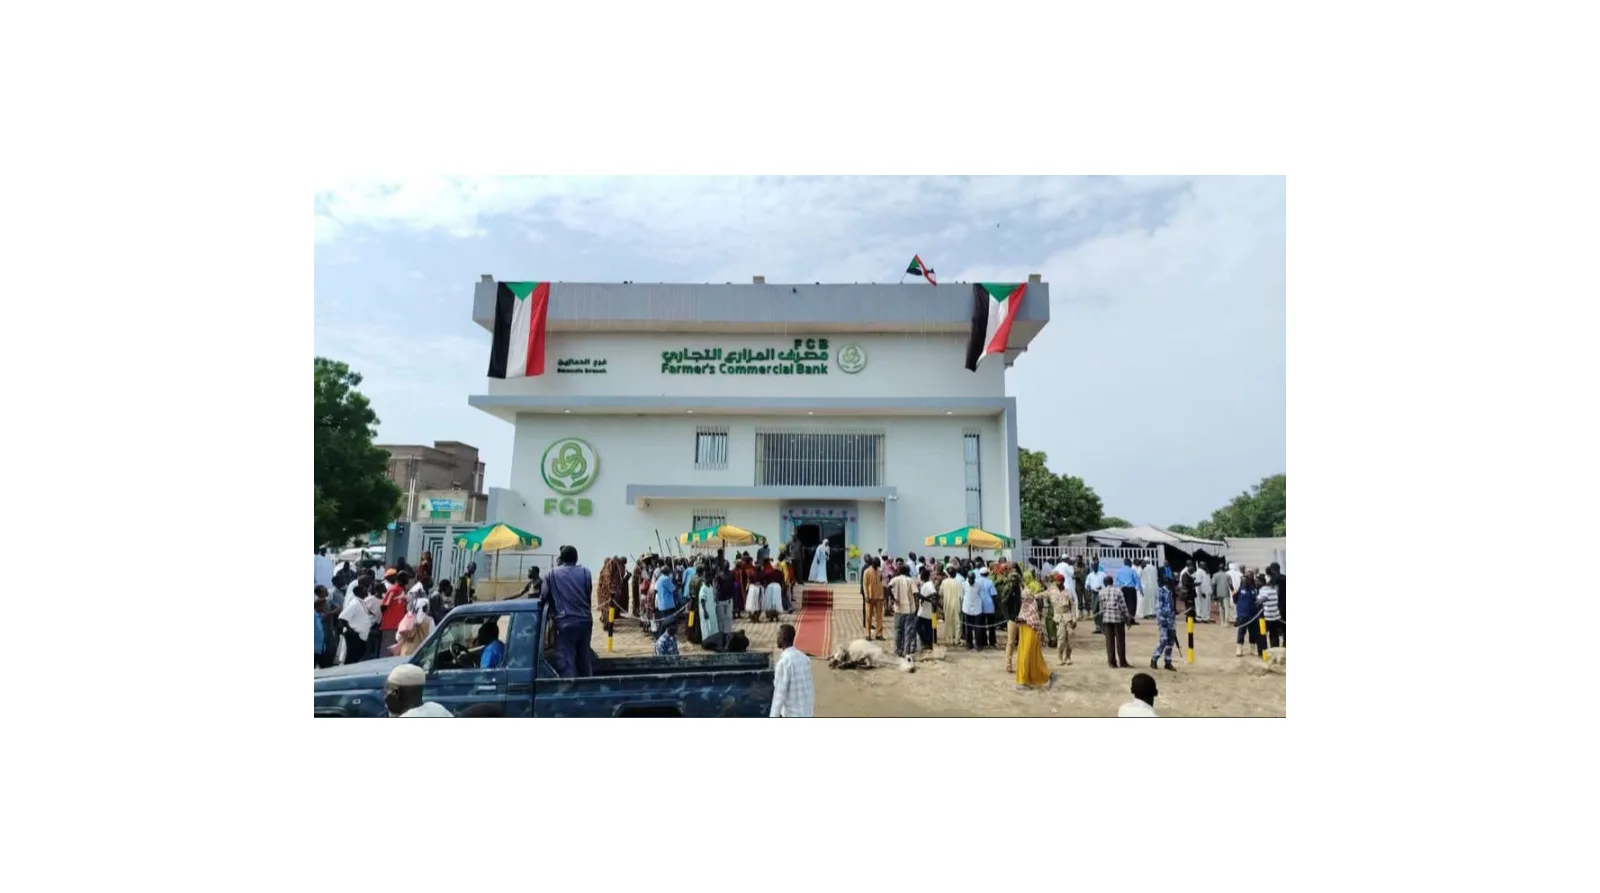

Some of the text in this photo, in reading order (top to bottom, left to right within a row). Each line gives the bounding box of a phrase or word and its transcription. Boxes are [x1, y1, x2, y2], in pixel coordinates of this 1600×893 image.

[661, 348, 829, 363] مصرف المزارع التجاري
[661, 363, 828, 375] Farmer's Commercial Bank
[543, 498, 593, 516] FCB
